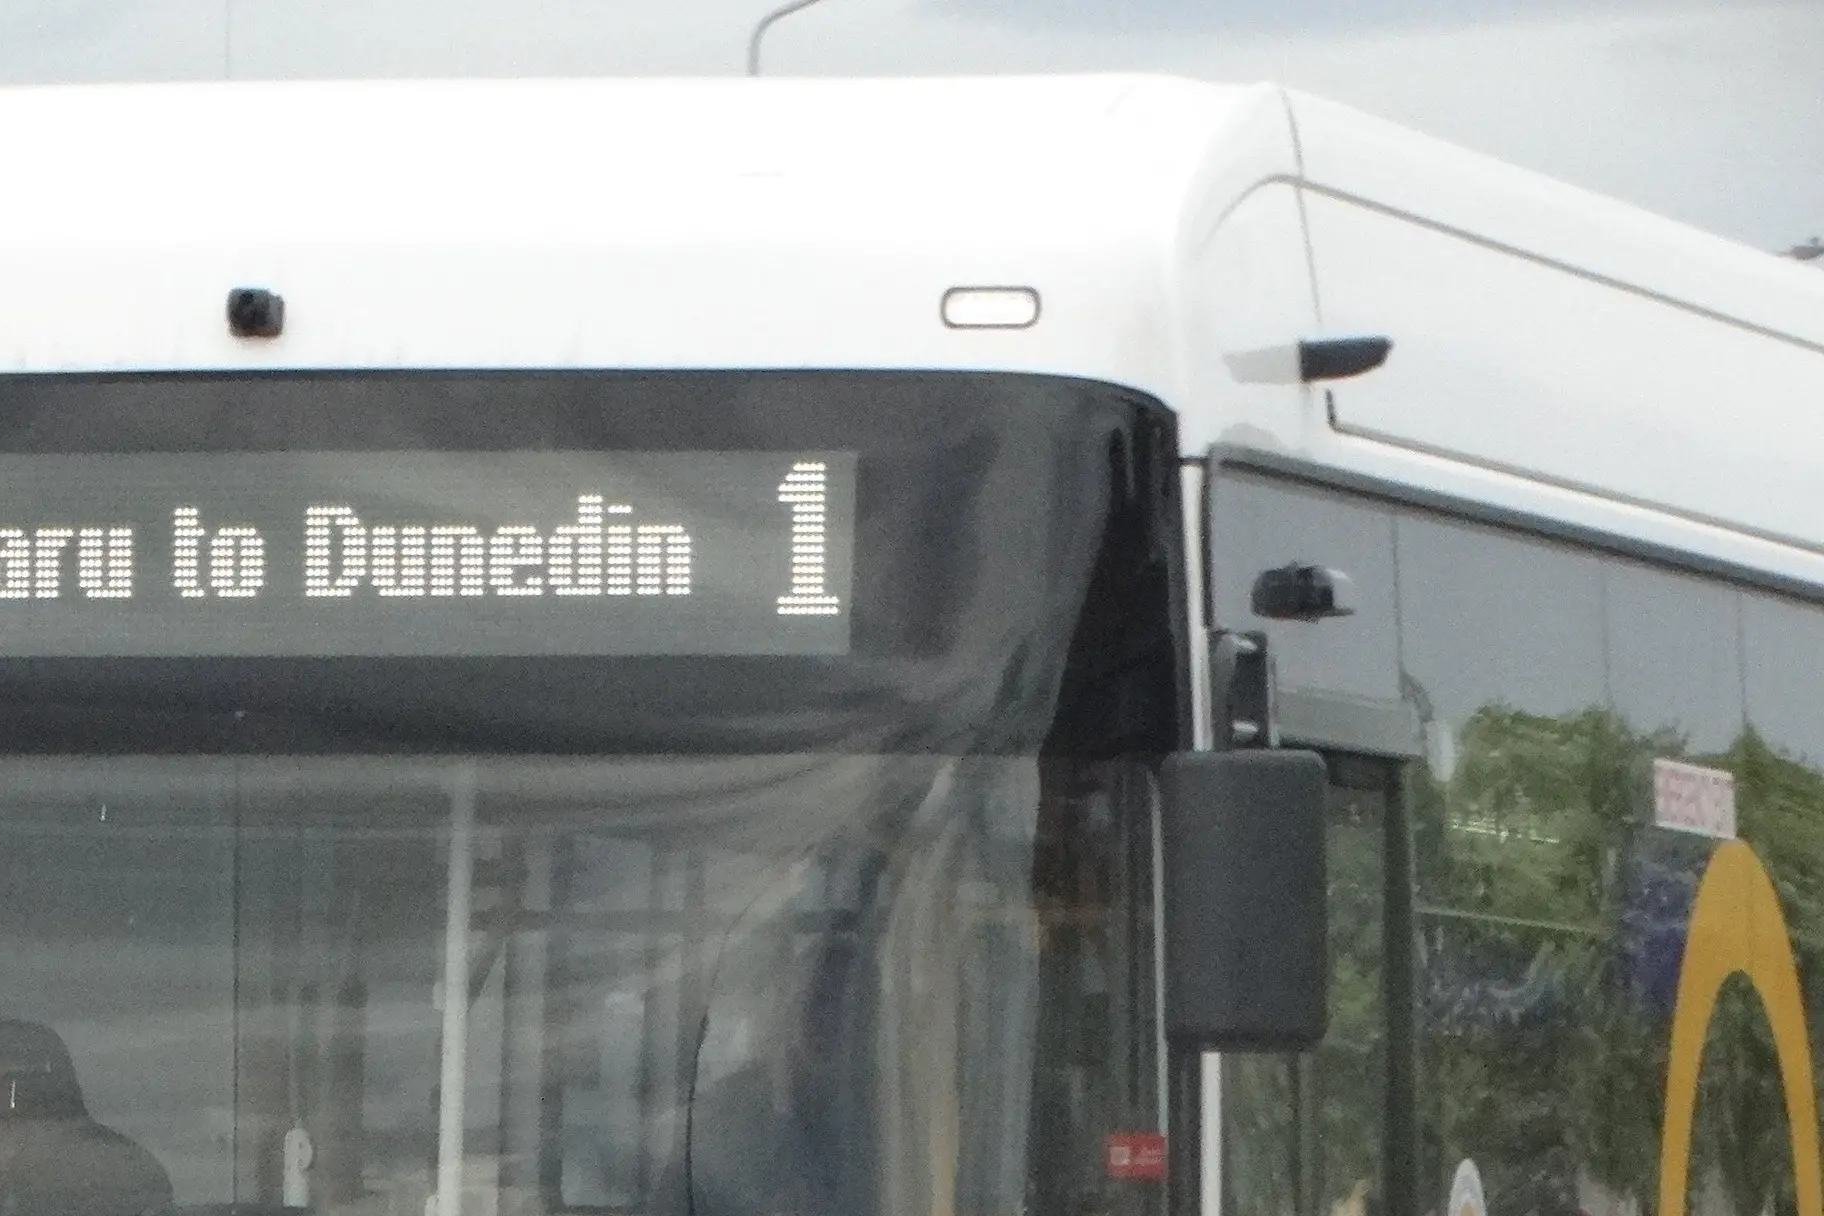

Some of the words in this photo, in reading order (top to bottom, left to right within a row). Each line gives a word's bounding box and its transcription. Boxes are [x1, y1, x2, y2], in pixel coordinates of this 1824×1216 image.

[174, 505, 265, 599] to
[305, 494, 692, 598] Dunedin
[777, 461, 839, 615] 1
